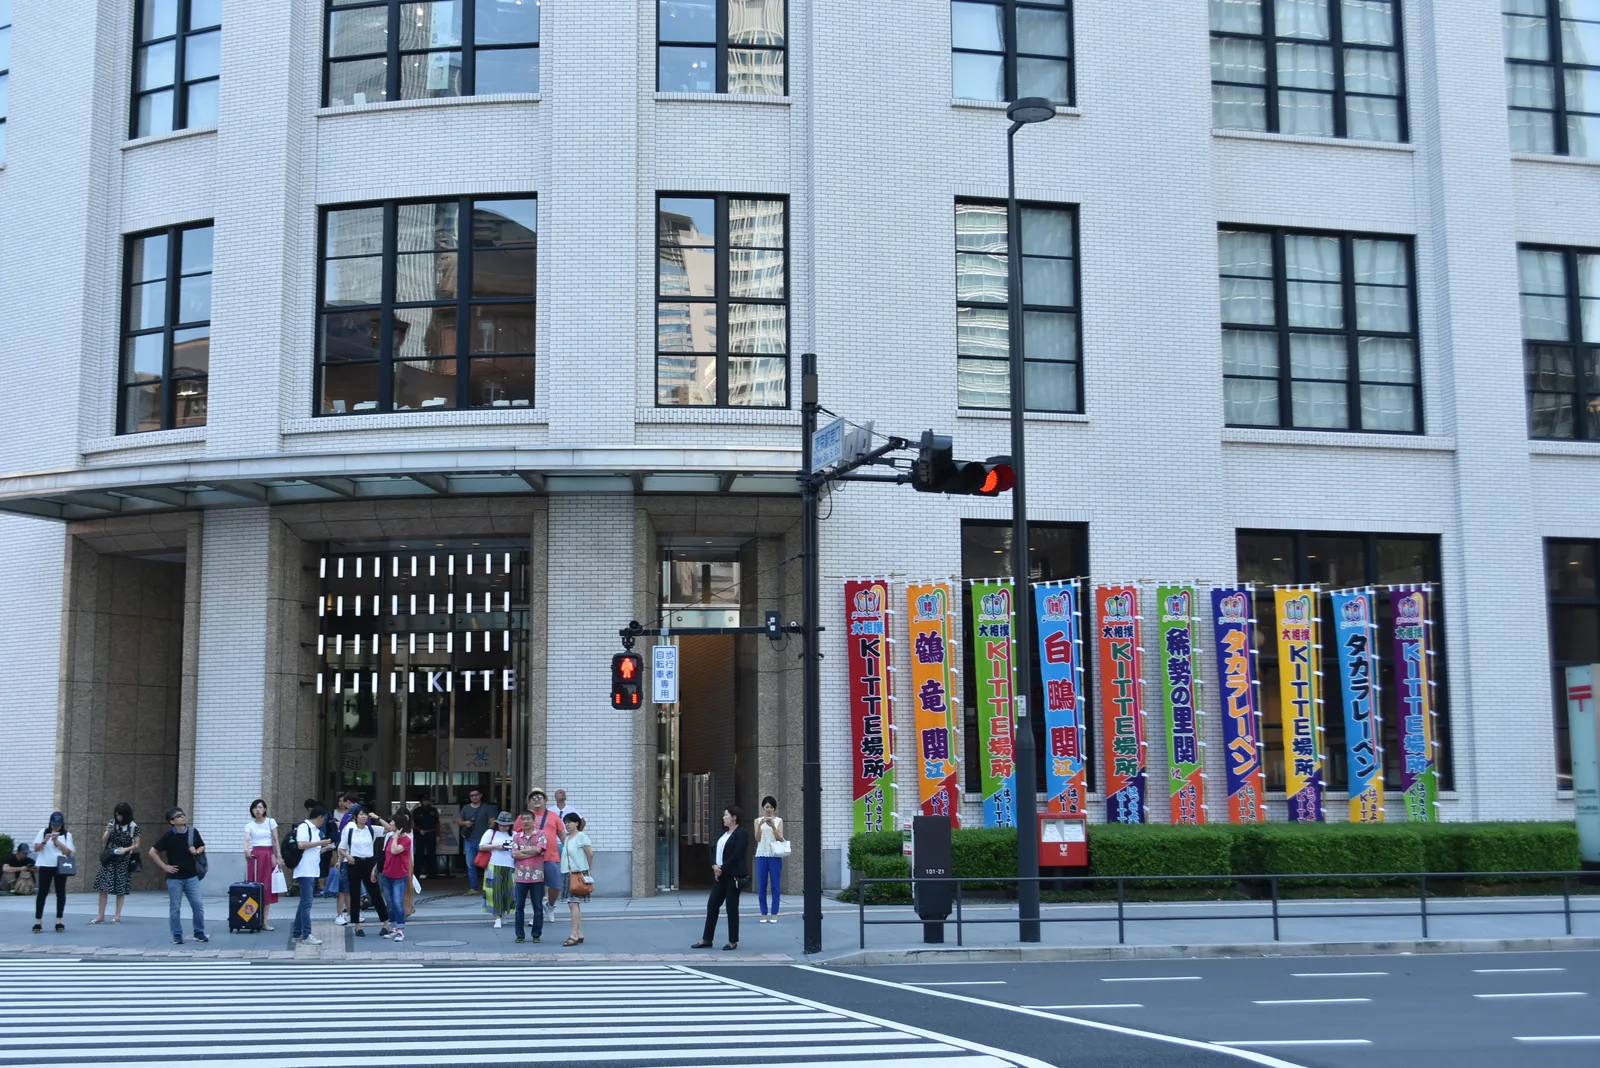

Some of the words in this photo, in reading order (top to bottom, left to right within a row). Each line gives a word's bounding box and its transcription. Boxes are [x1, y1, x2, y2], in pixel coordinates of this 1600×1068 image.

[427, 669, 517, 692] KITTE
[851, 620, 885, 635] 大相撲
[978, 623, 1011, 638] 大相撲
[1102, 624, 1135, 639] 大相撲
[1281, 628, 1312, 641] 大相撲
[1394, 626, 1424, 640] 大相撲
[859, 638, 885, 779] KITTE場所
[986, 641, 1014, 779] KITTE場所
[1111, 642, 1140, 777] KITTE場所
[1220, 629, 1256, 776] タカラレーベン
[1289, 644, 1315, 777] KITTE場所
[1344, 633, 1377, 779] タカラレーベン
[1402, 642, 1429, 774] KITTE場所
